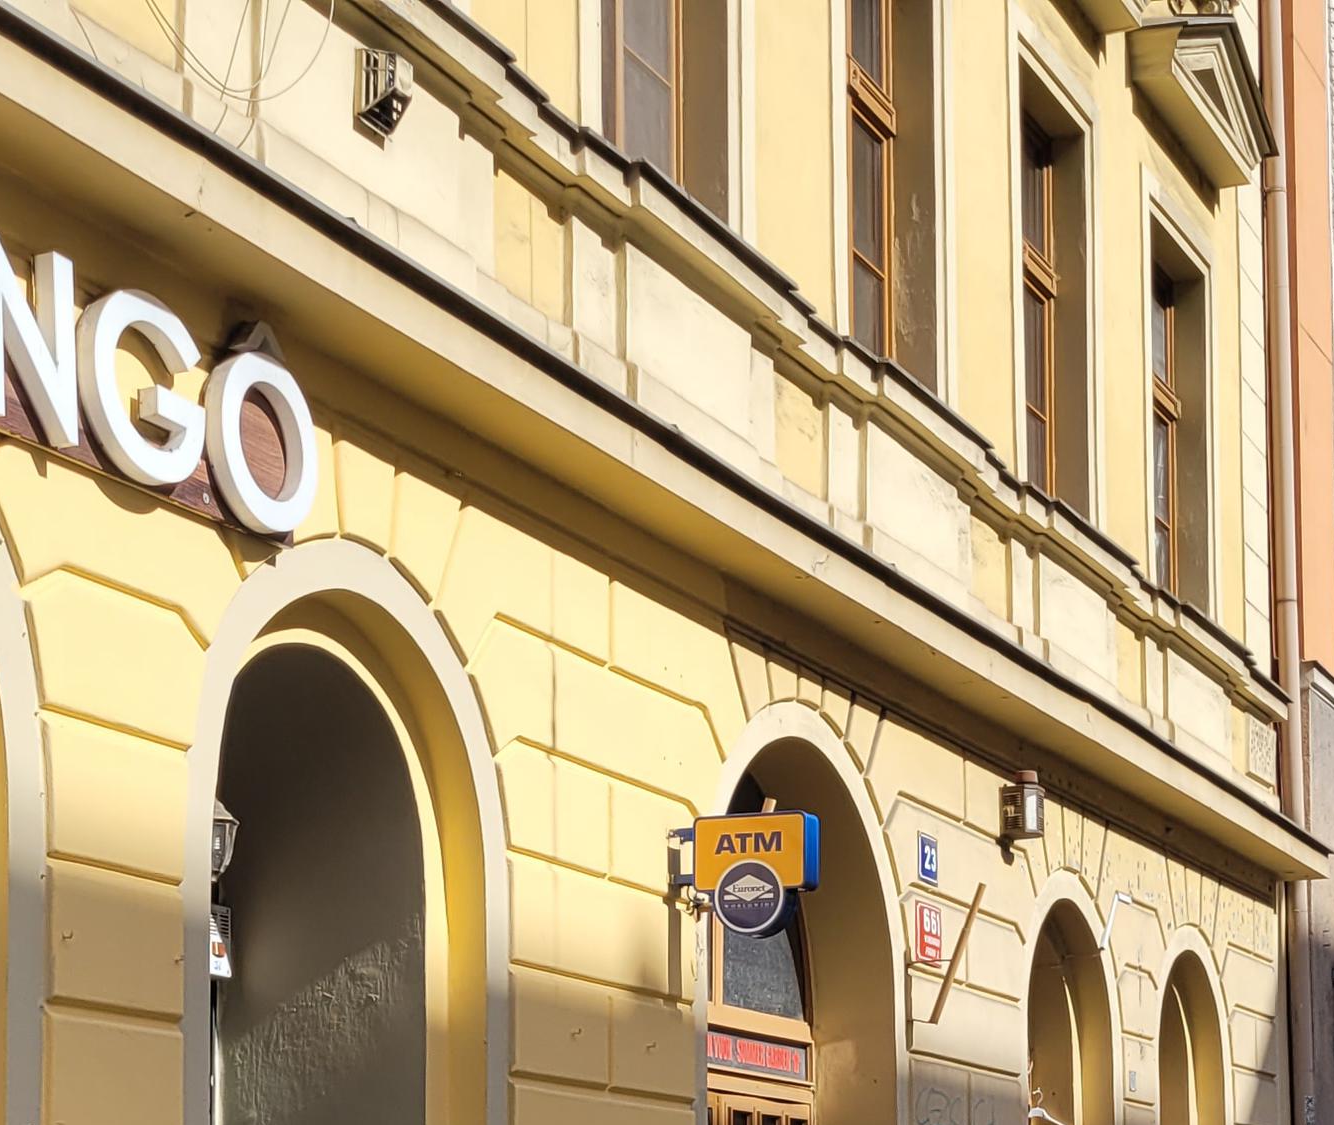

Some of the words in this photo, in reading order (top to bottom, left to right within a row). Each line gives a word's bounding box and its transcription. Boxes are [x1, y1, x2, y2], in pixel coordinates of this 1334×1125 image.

[715, 831, 783, 855] ATM
[924, 845, 937, 873] 23
[732, 884, 766, 893] Euronet
[923, 907, 941, 937] 661
